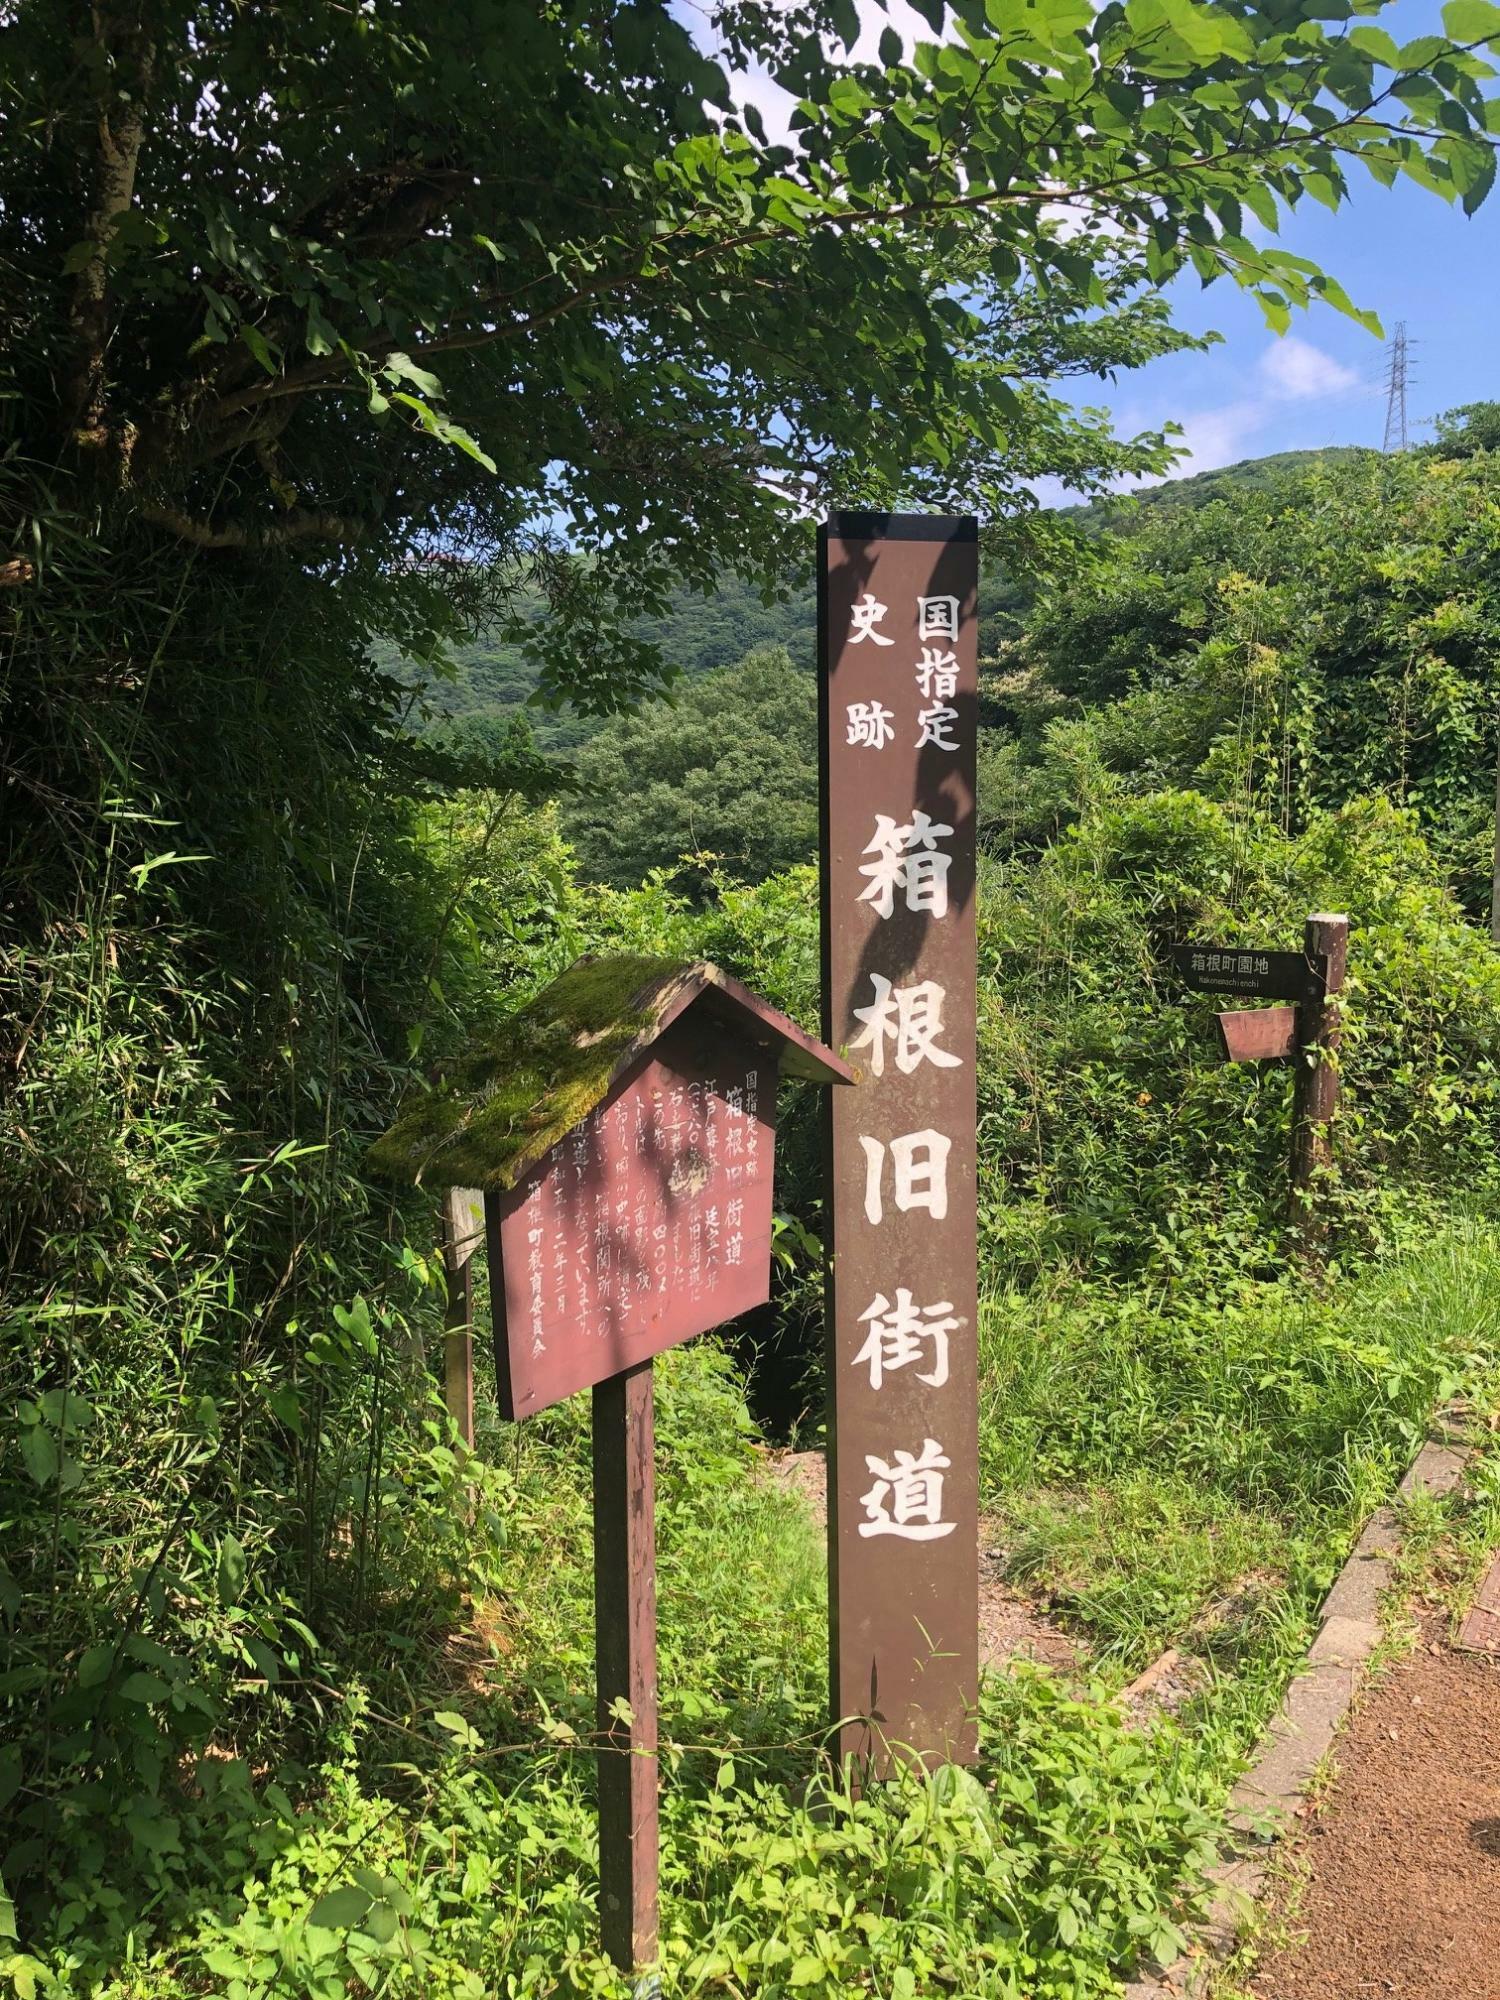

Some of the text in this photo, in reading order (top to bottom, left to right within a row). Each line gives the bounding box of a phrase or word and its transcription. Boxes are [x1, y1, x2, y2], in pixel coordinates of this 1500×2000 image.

[846, 593, 896, 752] 史跡
[913, 595, 960, 751] 国指定
[1191, 953, 1269, 975] 箱根町園地
[724, 1085, 744, 1265] 箱根旧街道
[850, 809, 965, 1543] 箱根旧街道
